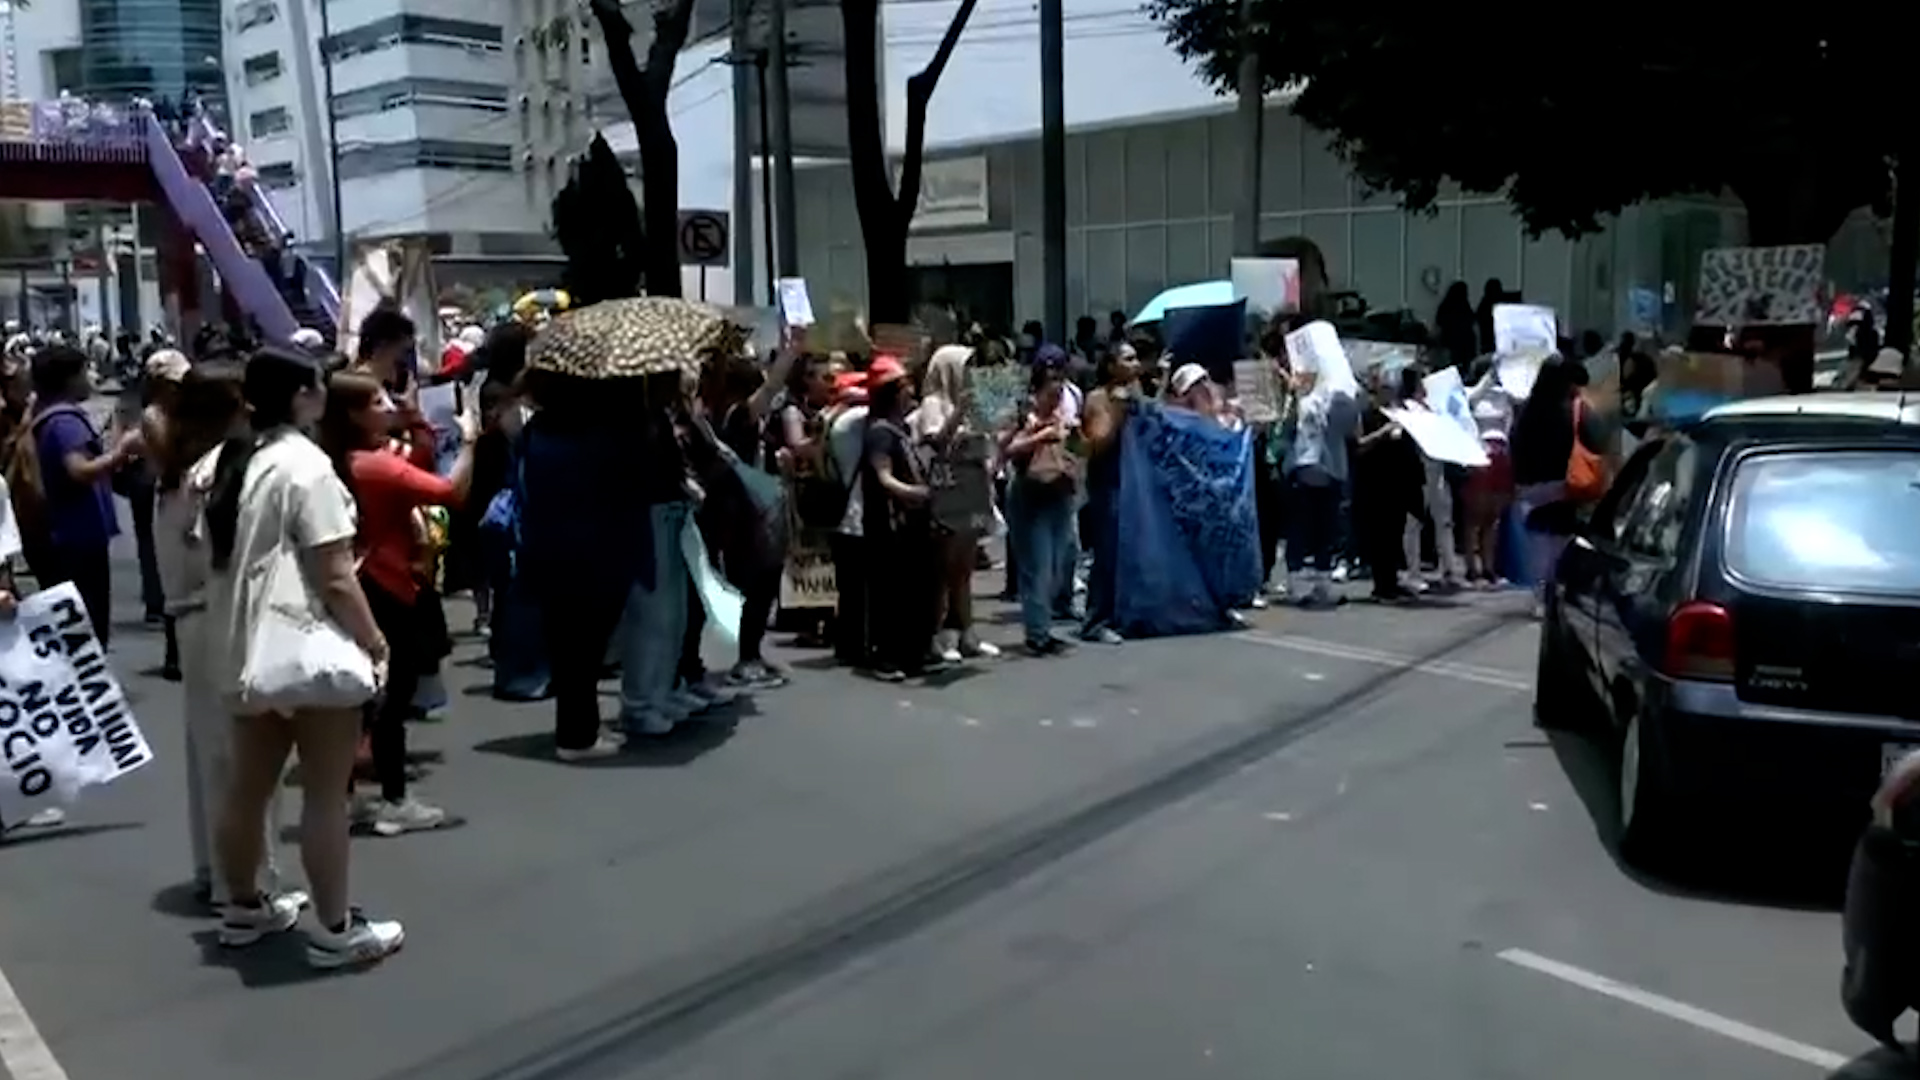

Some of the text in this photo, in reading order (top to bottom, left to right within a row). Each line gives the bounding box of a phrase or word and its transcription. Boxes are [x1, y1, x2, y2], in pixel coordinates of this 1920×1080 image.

[0, 675, 51, 796] OCIO
[17, 680, 59, 737] NO
[55, 684, 100, 755] VIDA
